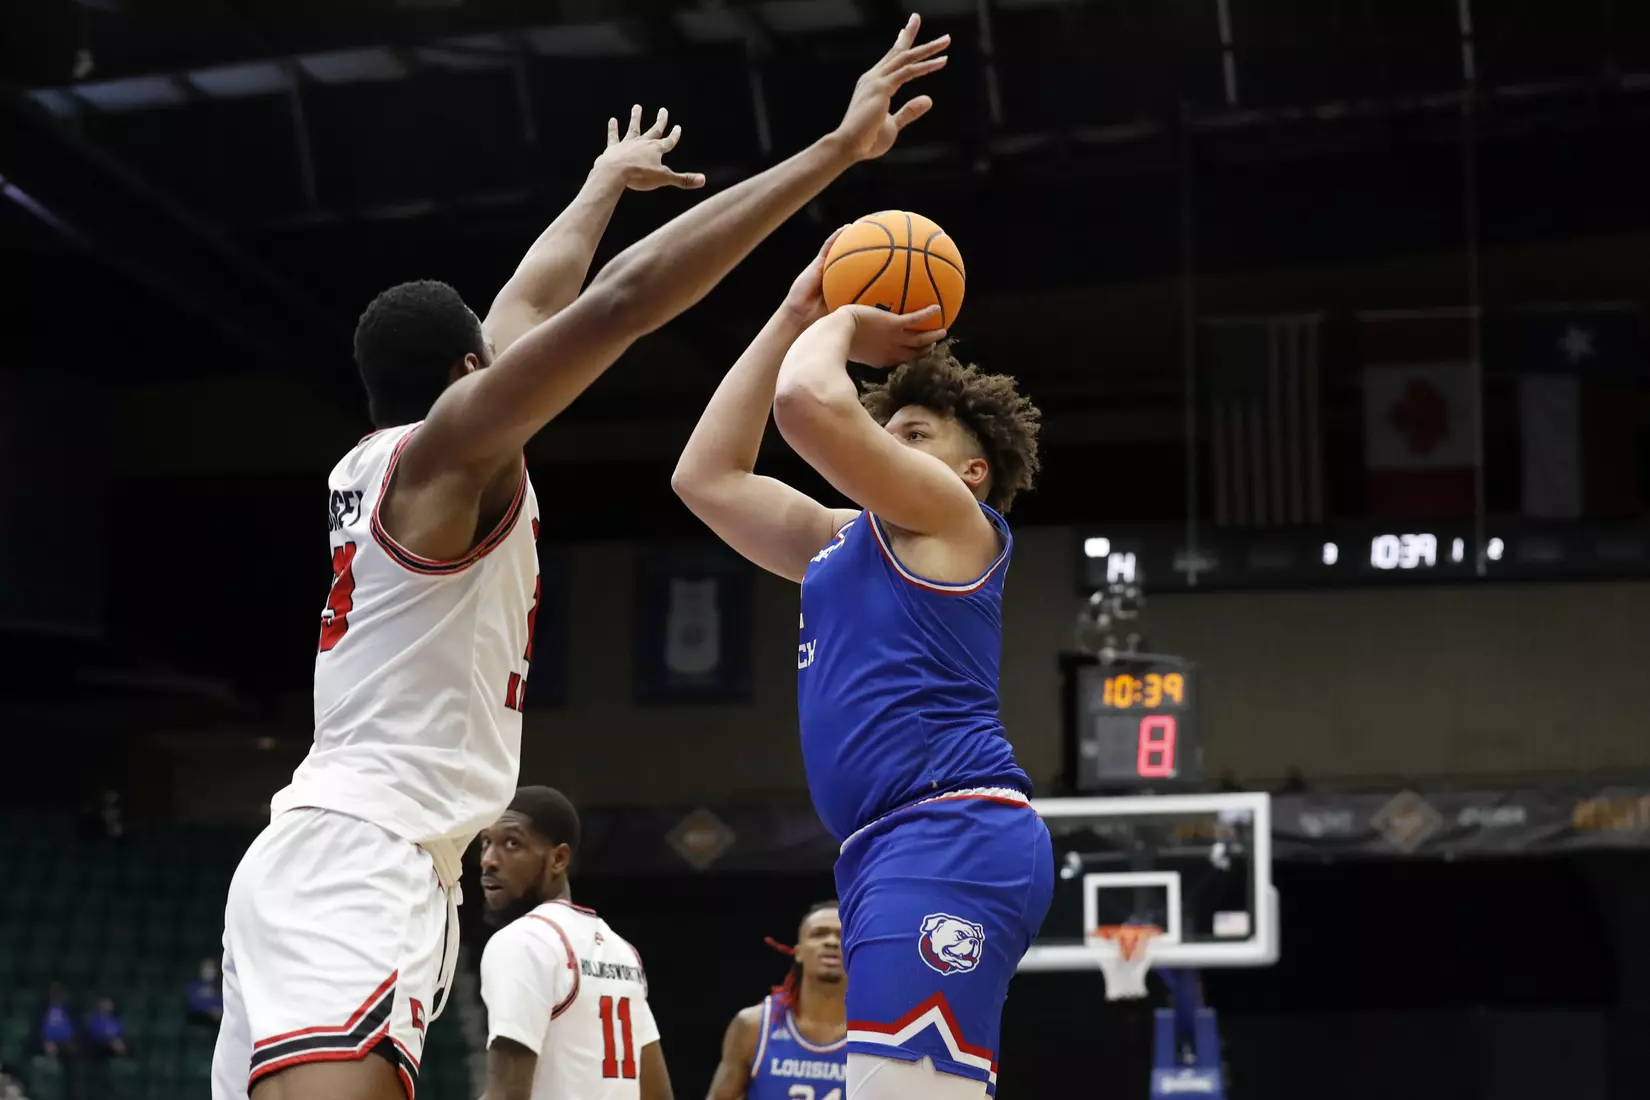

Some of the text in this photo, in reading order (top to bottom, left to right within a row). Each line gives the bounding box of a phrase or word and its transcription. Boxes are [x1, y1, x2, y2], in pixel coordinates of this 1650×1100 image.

[1103, 672, 1185, 708] 10:39
[1136, 714, 1177, 778] 8
[599, 995, 637, 1079] 11
[770, 1058, 848, 1082] LOUISIAN
